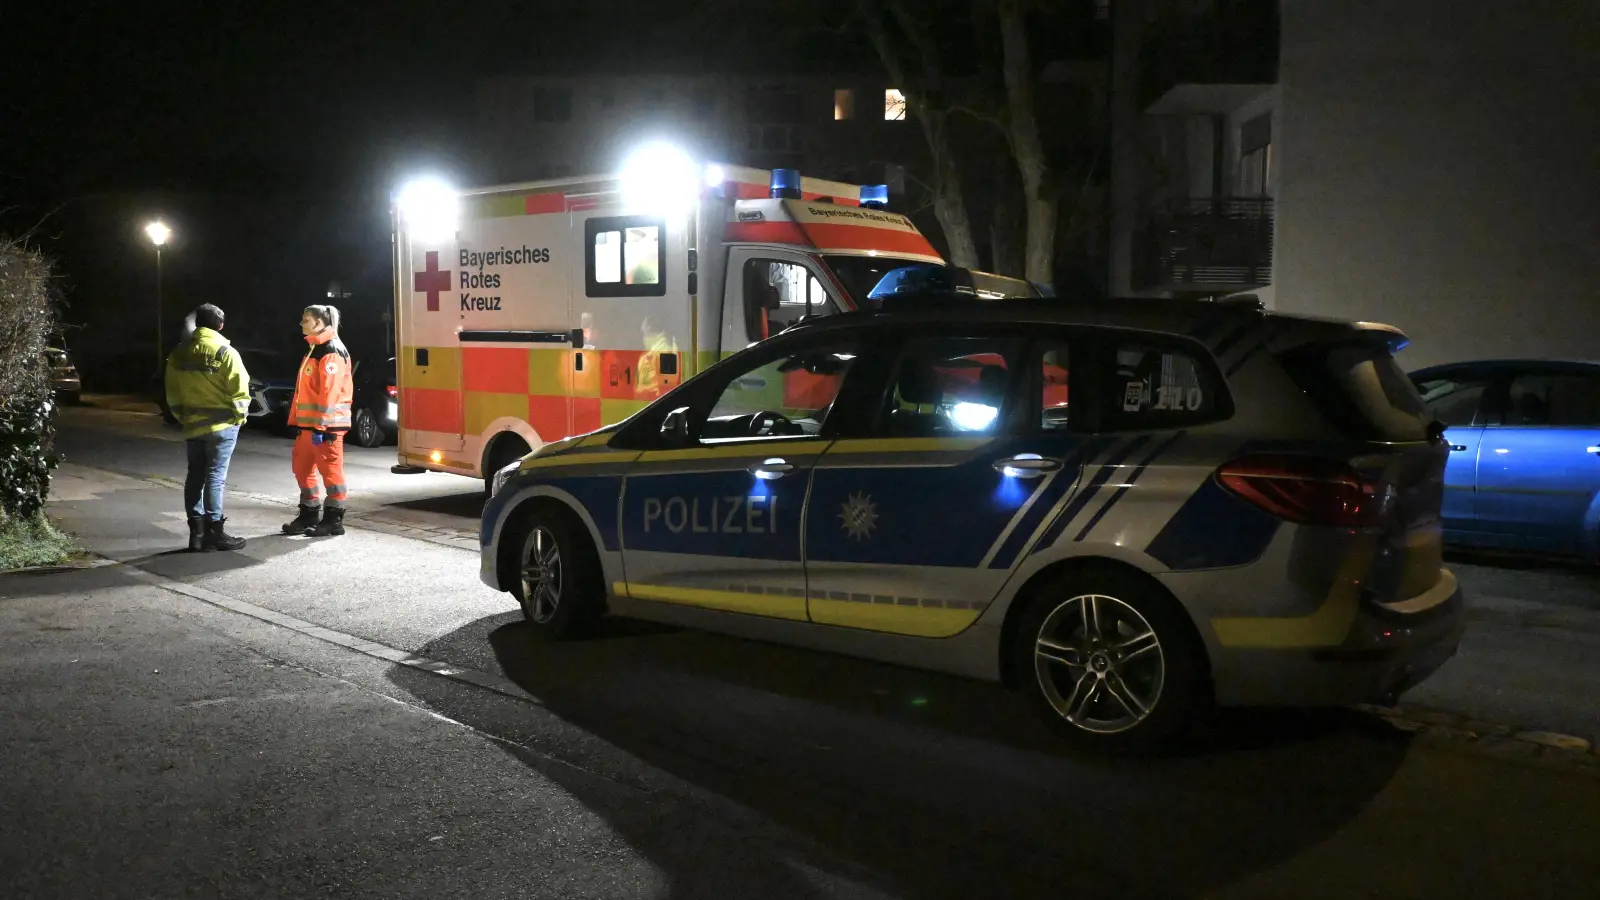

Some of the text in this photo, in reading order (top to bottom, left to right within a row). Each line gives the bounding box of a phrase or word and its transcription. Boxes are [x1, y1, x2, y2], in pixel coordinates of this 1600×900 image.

[460, 245, 550, 270] Bayerisches
[460, 271, 501, 289] Rotes
[460, 293, 501, 311] Kreuz
[1151, 386, 1203, 411] 110
[643, 495, 778, 534] POLIZEI
